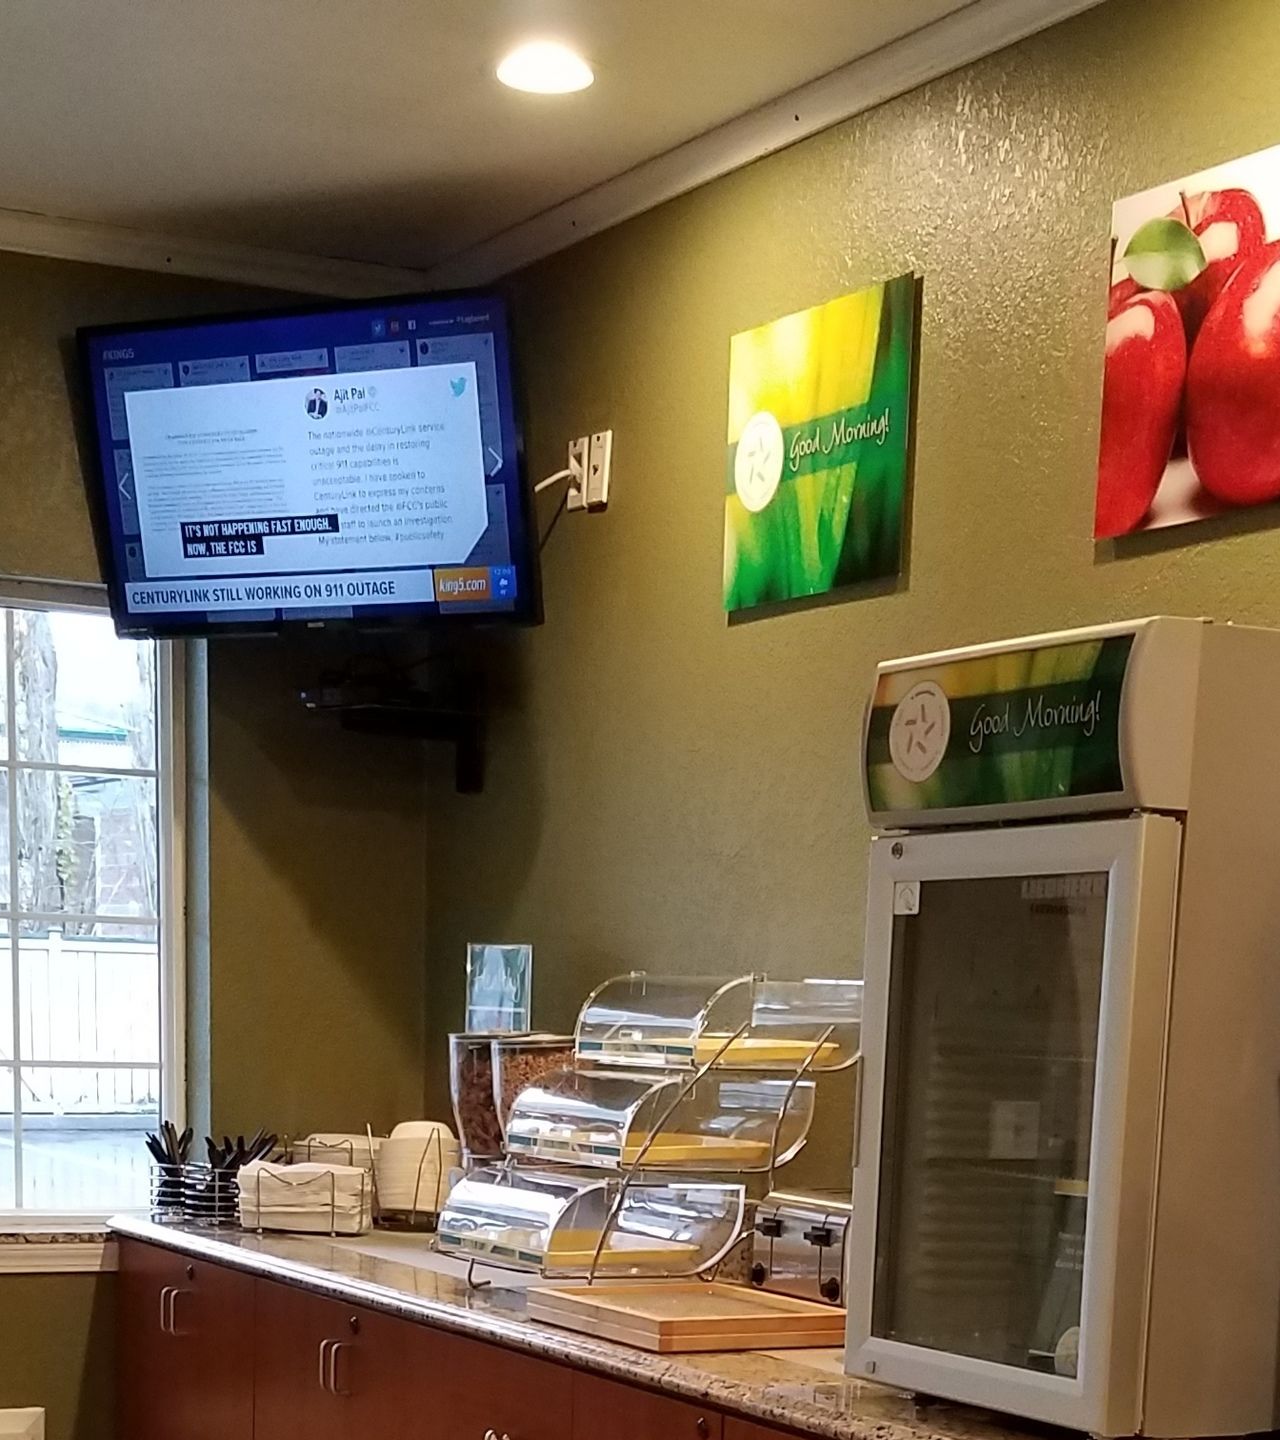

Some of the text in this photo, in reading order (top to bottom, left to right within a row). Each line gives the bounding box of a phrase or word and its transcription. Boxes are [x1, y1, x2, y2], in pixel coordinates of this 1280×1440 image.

[334, 387, 349, 403] Ajit
[790, 407, 890, 472] Good Morning!
[185, 517, 332, 538] IT'S NOT HAPPENING FAST ENOUGH.
[187, 540, 256, 556] NOW, THE FCC IS
[132, 581, 395, 605] CENTURYLINK STILL WORKING ON 911 OUTAGE
[439, 578, 486, 595] king5.com
[969, 690, 1101, 753] Good Morning!
